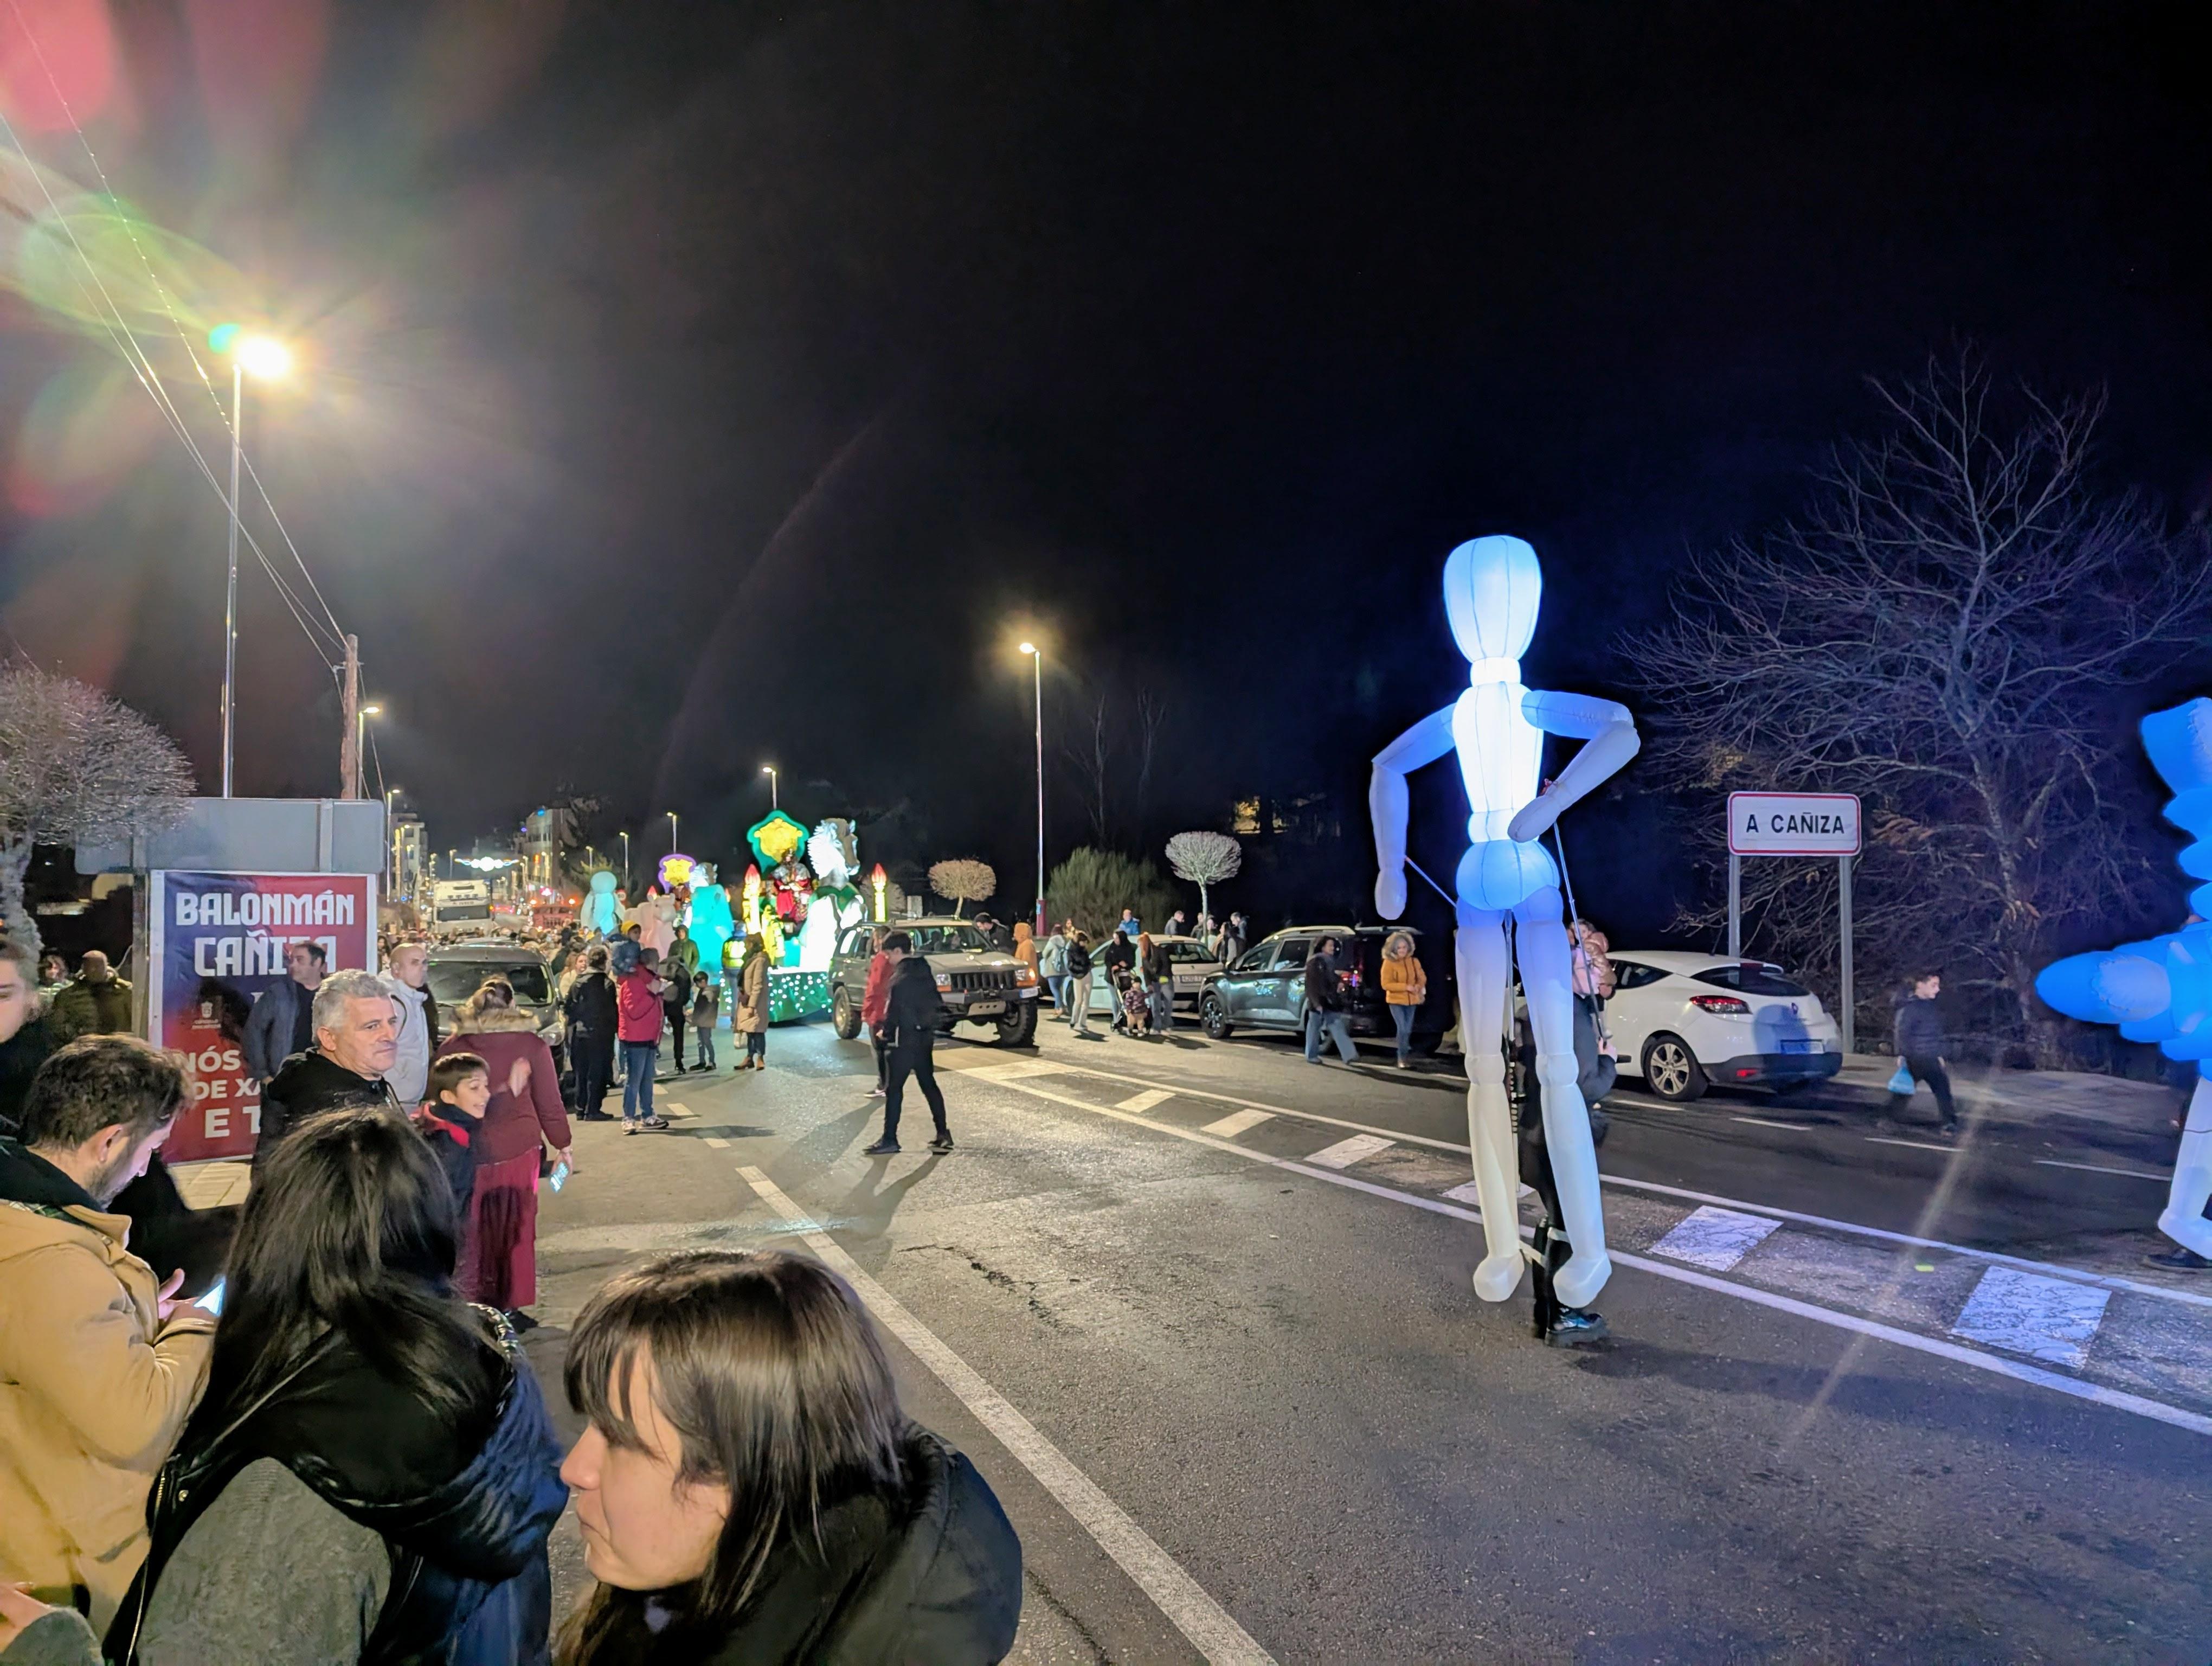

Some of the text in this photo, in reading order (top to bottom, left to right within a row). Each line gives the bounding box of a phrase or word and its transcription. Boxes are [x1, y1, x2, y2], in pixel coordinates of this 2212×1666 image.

[1746, 812, 1844, 834] A CAÑIZA
[176, 889, 354, 926] BALONMÁN
[194, 929, 337, 976] CAÑIA
[205, 1108, 230, 1138] E
